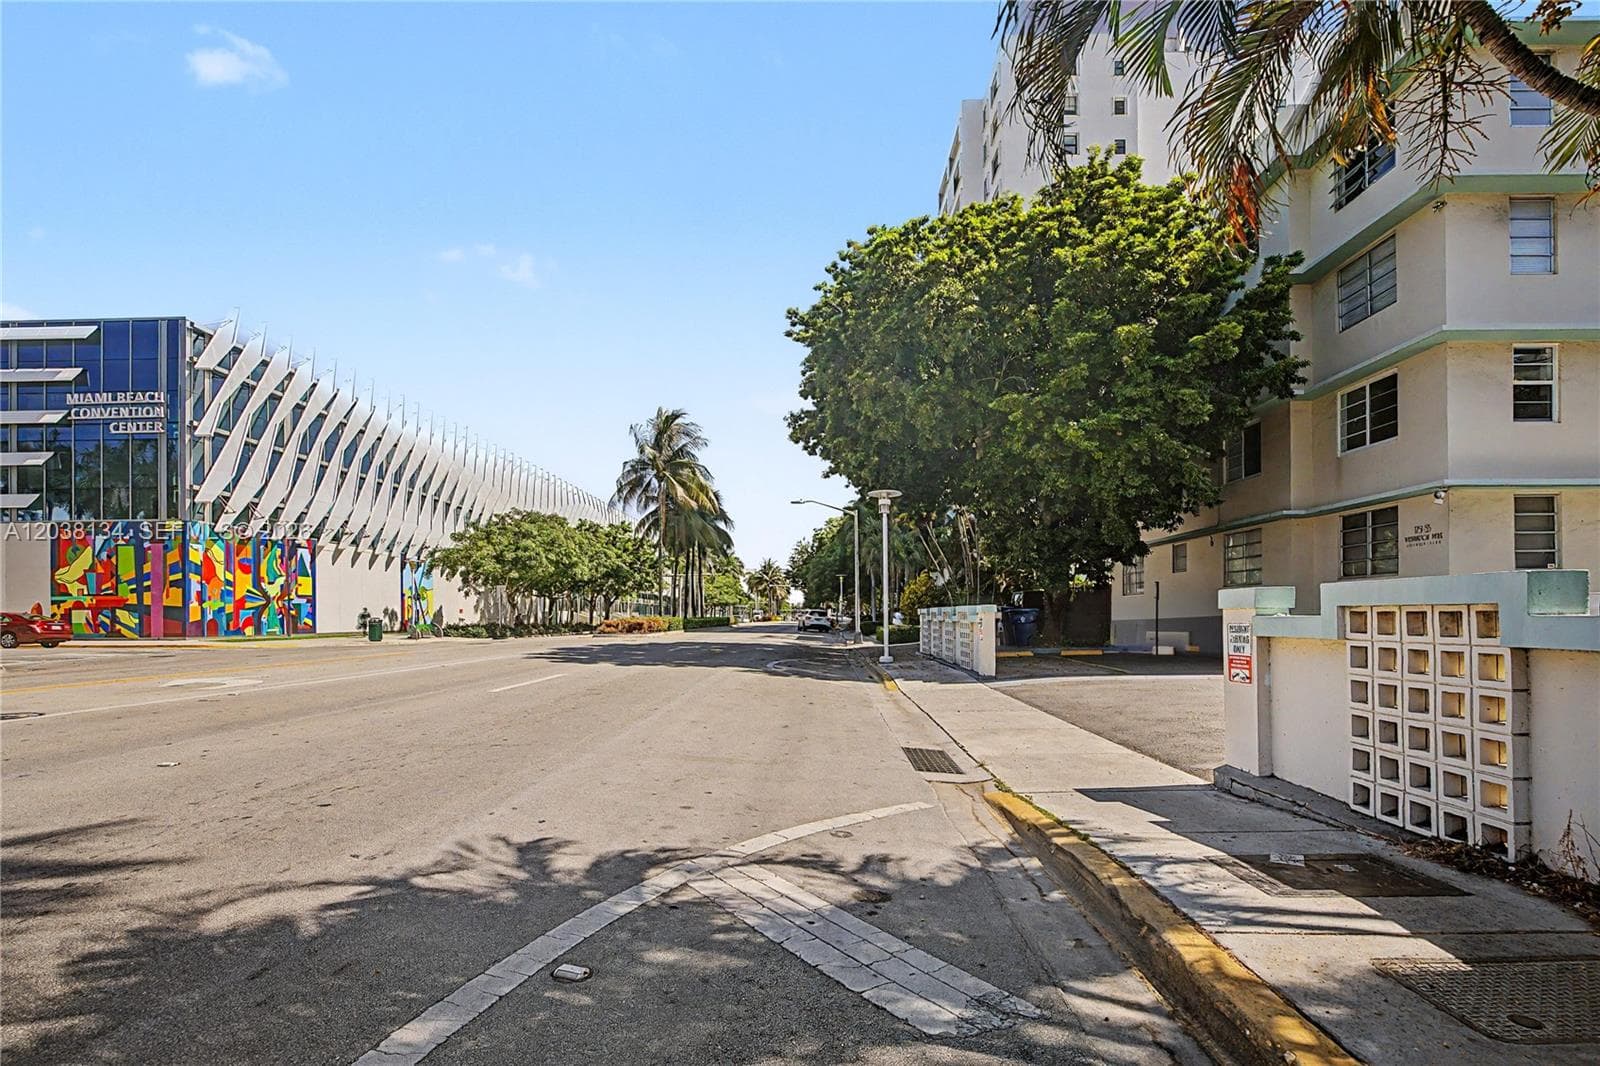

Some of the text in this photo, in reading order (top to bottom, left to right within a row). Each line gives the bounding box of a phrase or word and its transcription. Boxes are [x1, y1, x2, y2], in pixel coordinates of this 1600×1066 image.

[66, 391, 165, 404] MIAMI BEACH
[70, 406, 165, 418] CONVENTION
[109, 421, 165, 433] CENTER
